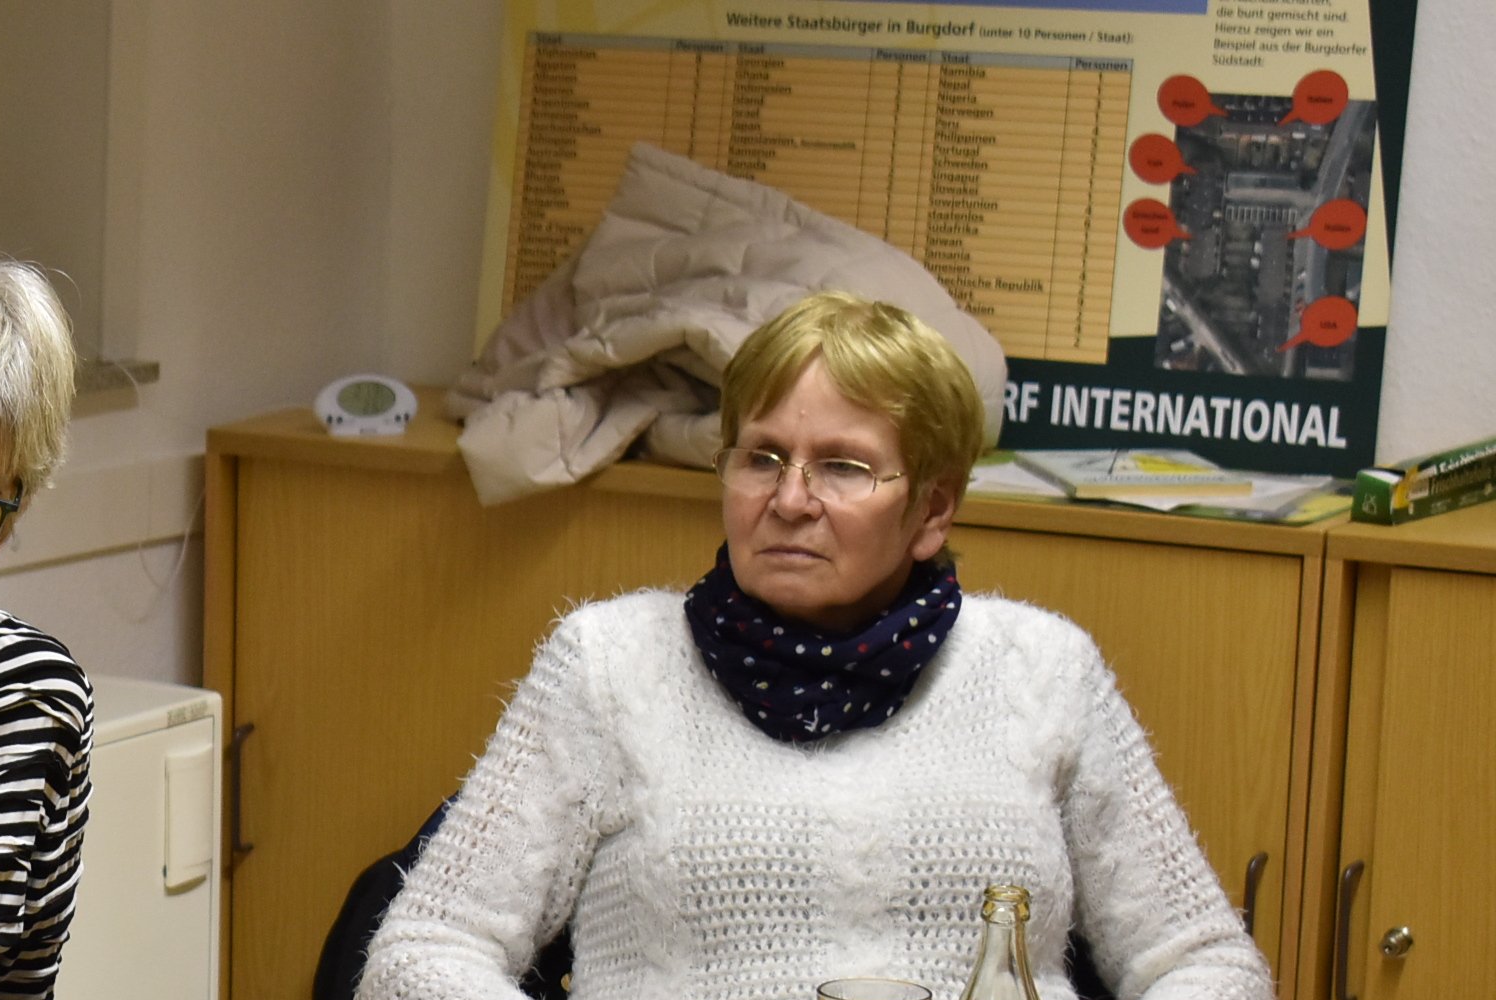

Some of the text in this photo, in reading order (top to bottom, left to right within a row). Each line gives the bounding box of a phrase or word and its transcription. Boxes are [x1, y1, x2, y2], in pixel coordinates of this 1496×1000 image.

[1217, 8, 1234, 18] die
[1237, 9, 1264, 19] bunt
[1267, 10, 1319, 22] gemischt
[726, 12, 782, 27] Weitere
[787, 15, 883, 35] Staatsbürger
[887, 18, 900, 33] in
[906, 20, 975, 39] Burgdorf
[979, 27, 1013, 38] (unter
[1017, 28, 1031, 39] 10
[1034, 30, 1086, 41] Personen
[1215, 23, 1334, 38] Hierzu zeigen wir ein
[1214, 39, 1368, 56] Beispiel aus der Burgdorfer
[939, 66, 986, 78] Namibia
[1075, 59, 1128, 71] Personen
[936, 106, 994, 119] Norwegen
[995, 280, 1044, 292] Republik
[1051, 385, 1347, 448] INTERNATIONAL
